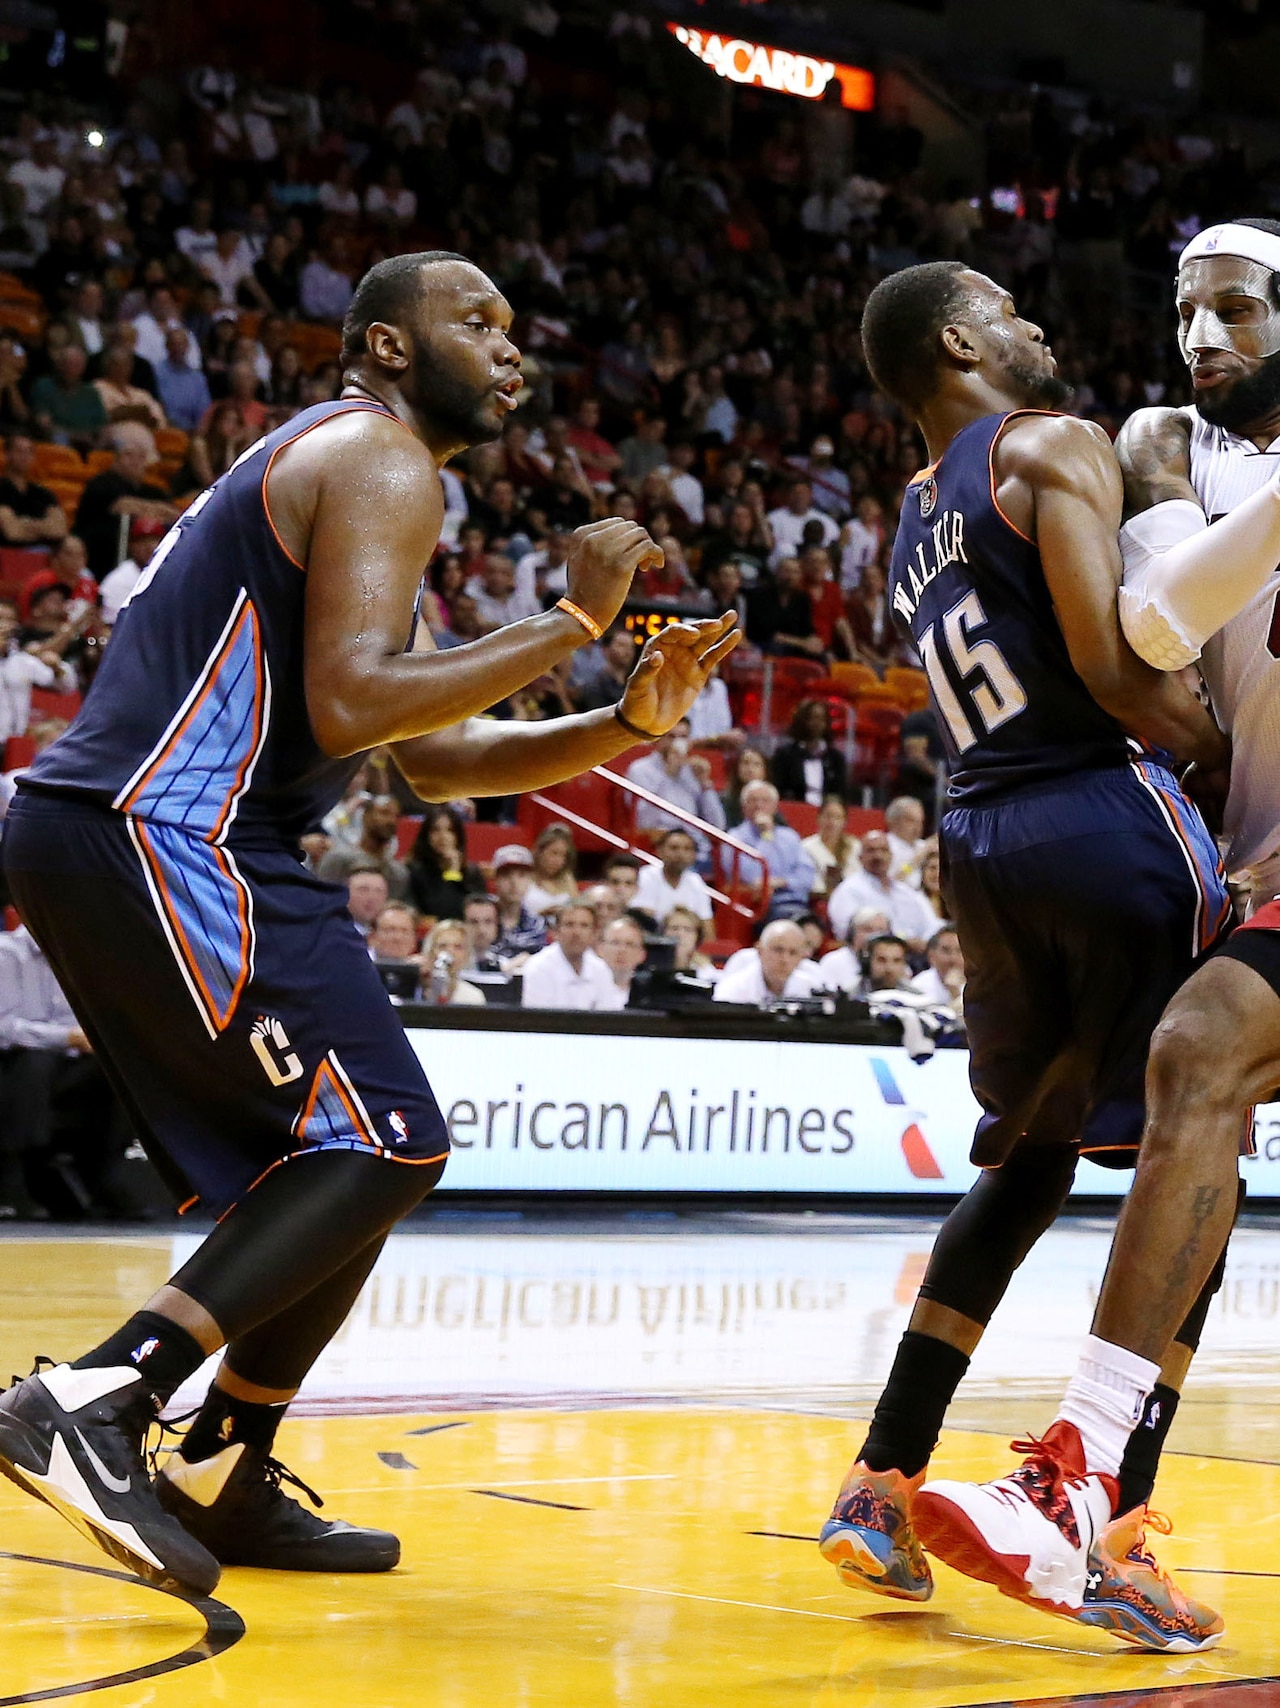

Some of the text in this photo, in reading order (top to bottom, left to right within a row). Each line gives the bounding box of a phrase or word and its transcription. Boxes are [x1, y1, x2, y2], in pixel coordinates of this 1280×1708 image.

[916, 588, 1028, 756] 15
[446, 1083, 856, 1154] erican Airlines
